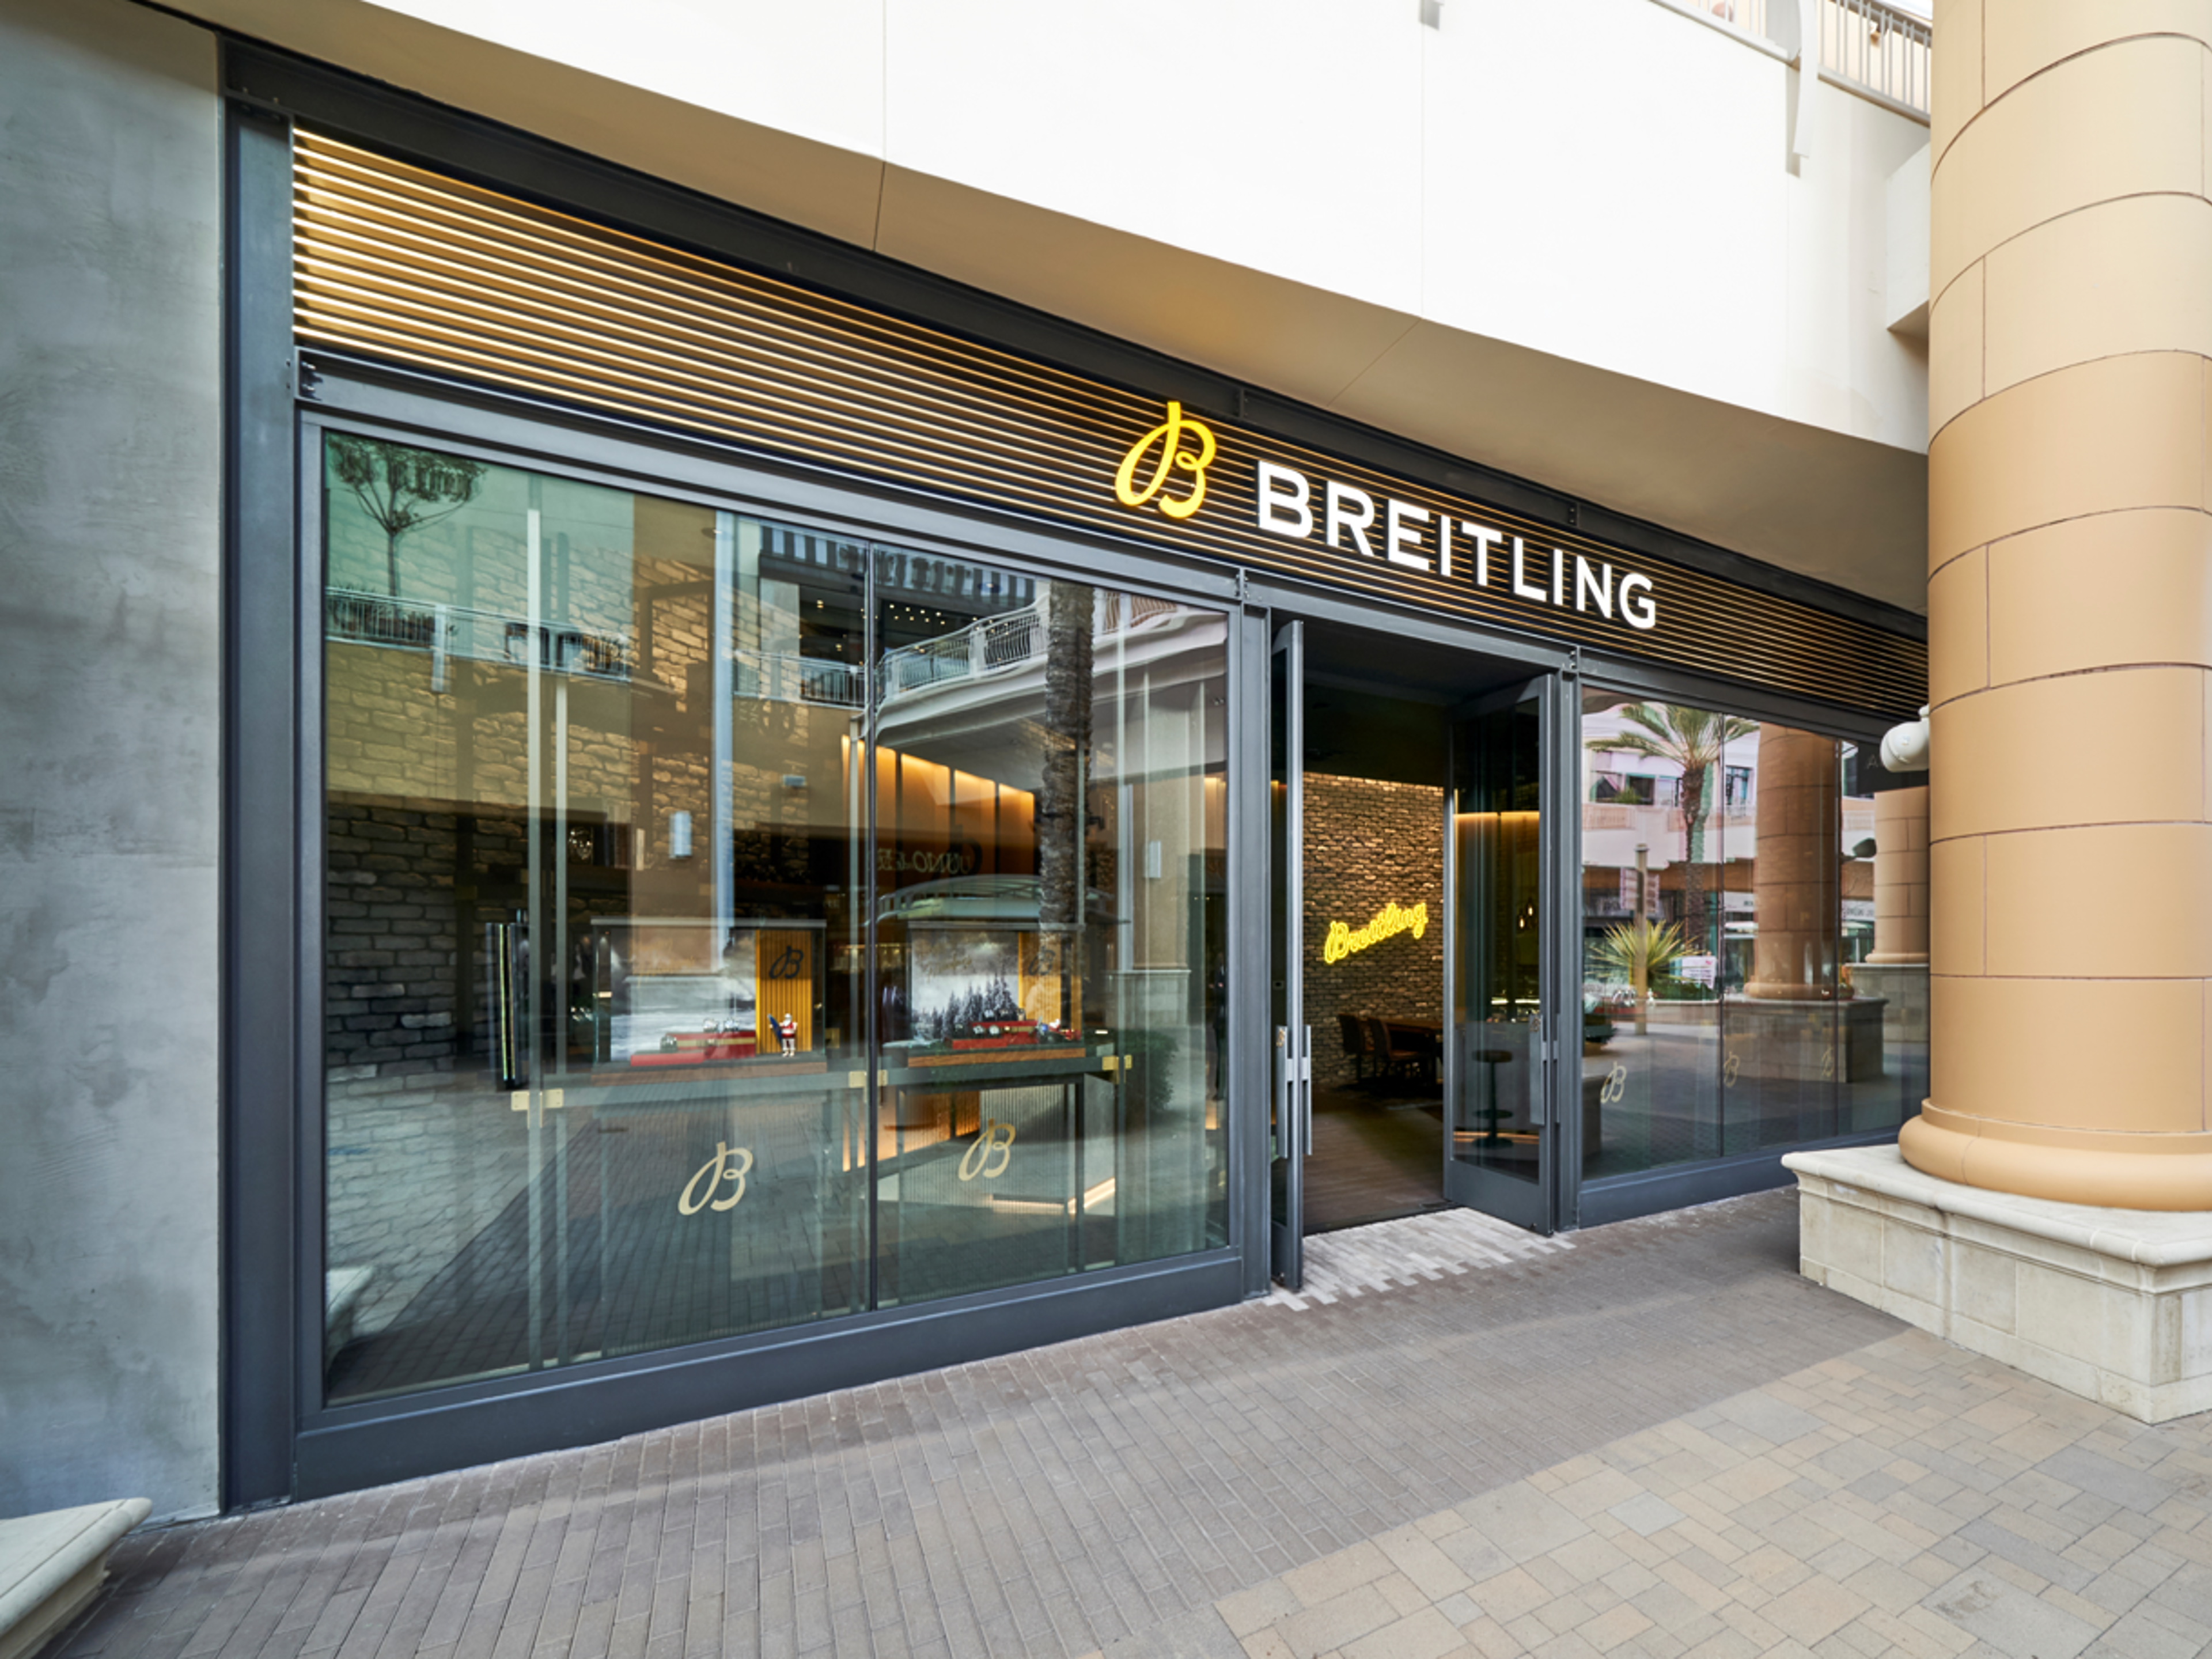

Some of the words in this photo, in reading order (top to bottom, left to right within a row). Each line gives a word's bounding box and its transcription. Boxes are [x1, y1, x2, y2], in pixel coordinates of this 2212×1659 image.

[1115, 401, 1217, 519] B
[1257, 460, 1657, 629] BREITLING
[1325, 903, 1429, 964] Breitling
[678, 1142, 753, 1215] B
[958, 1118, 1016, 1181] B
